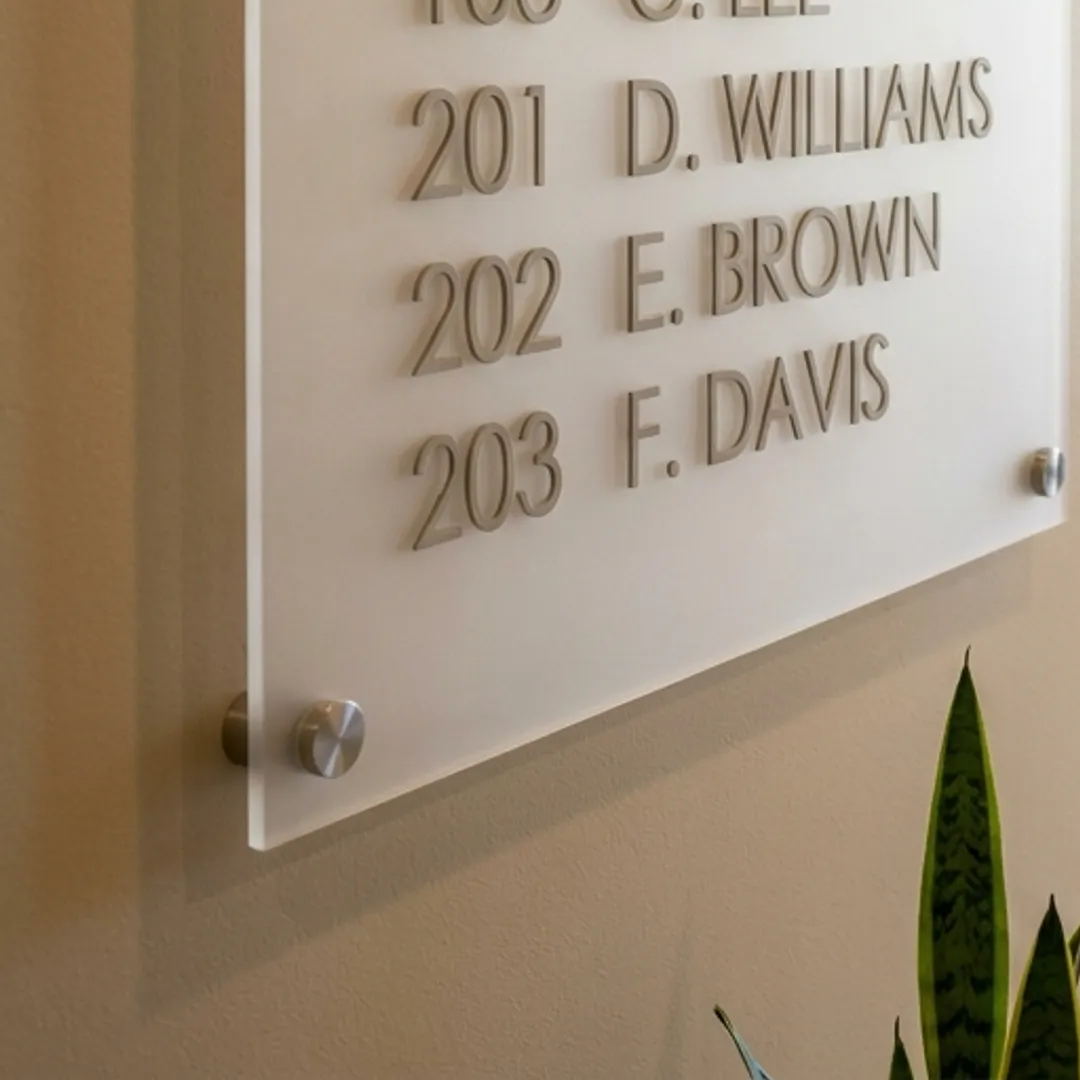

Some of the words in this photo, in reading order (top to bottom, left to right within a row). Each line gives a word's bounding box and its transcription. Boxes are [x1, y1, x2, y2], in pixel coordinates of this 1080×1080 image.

[411, 84, 546, 201] 201
[626, 78, 700, 177] D.
[721, 57, 993, 165] WILLIAMS
[411, 247, 563, 376] 202
[626, 231, 685, 333] E.
[709, 191, 941, 317] BROWN
[411, 411, 563, 552] 203
[626, 385, 680, 489] F.
[706, 332, 890, 466] DAVIS
